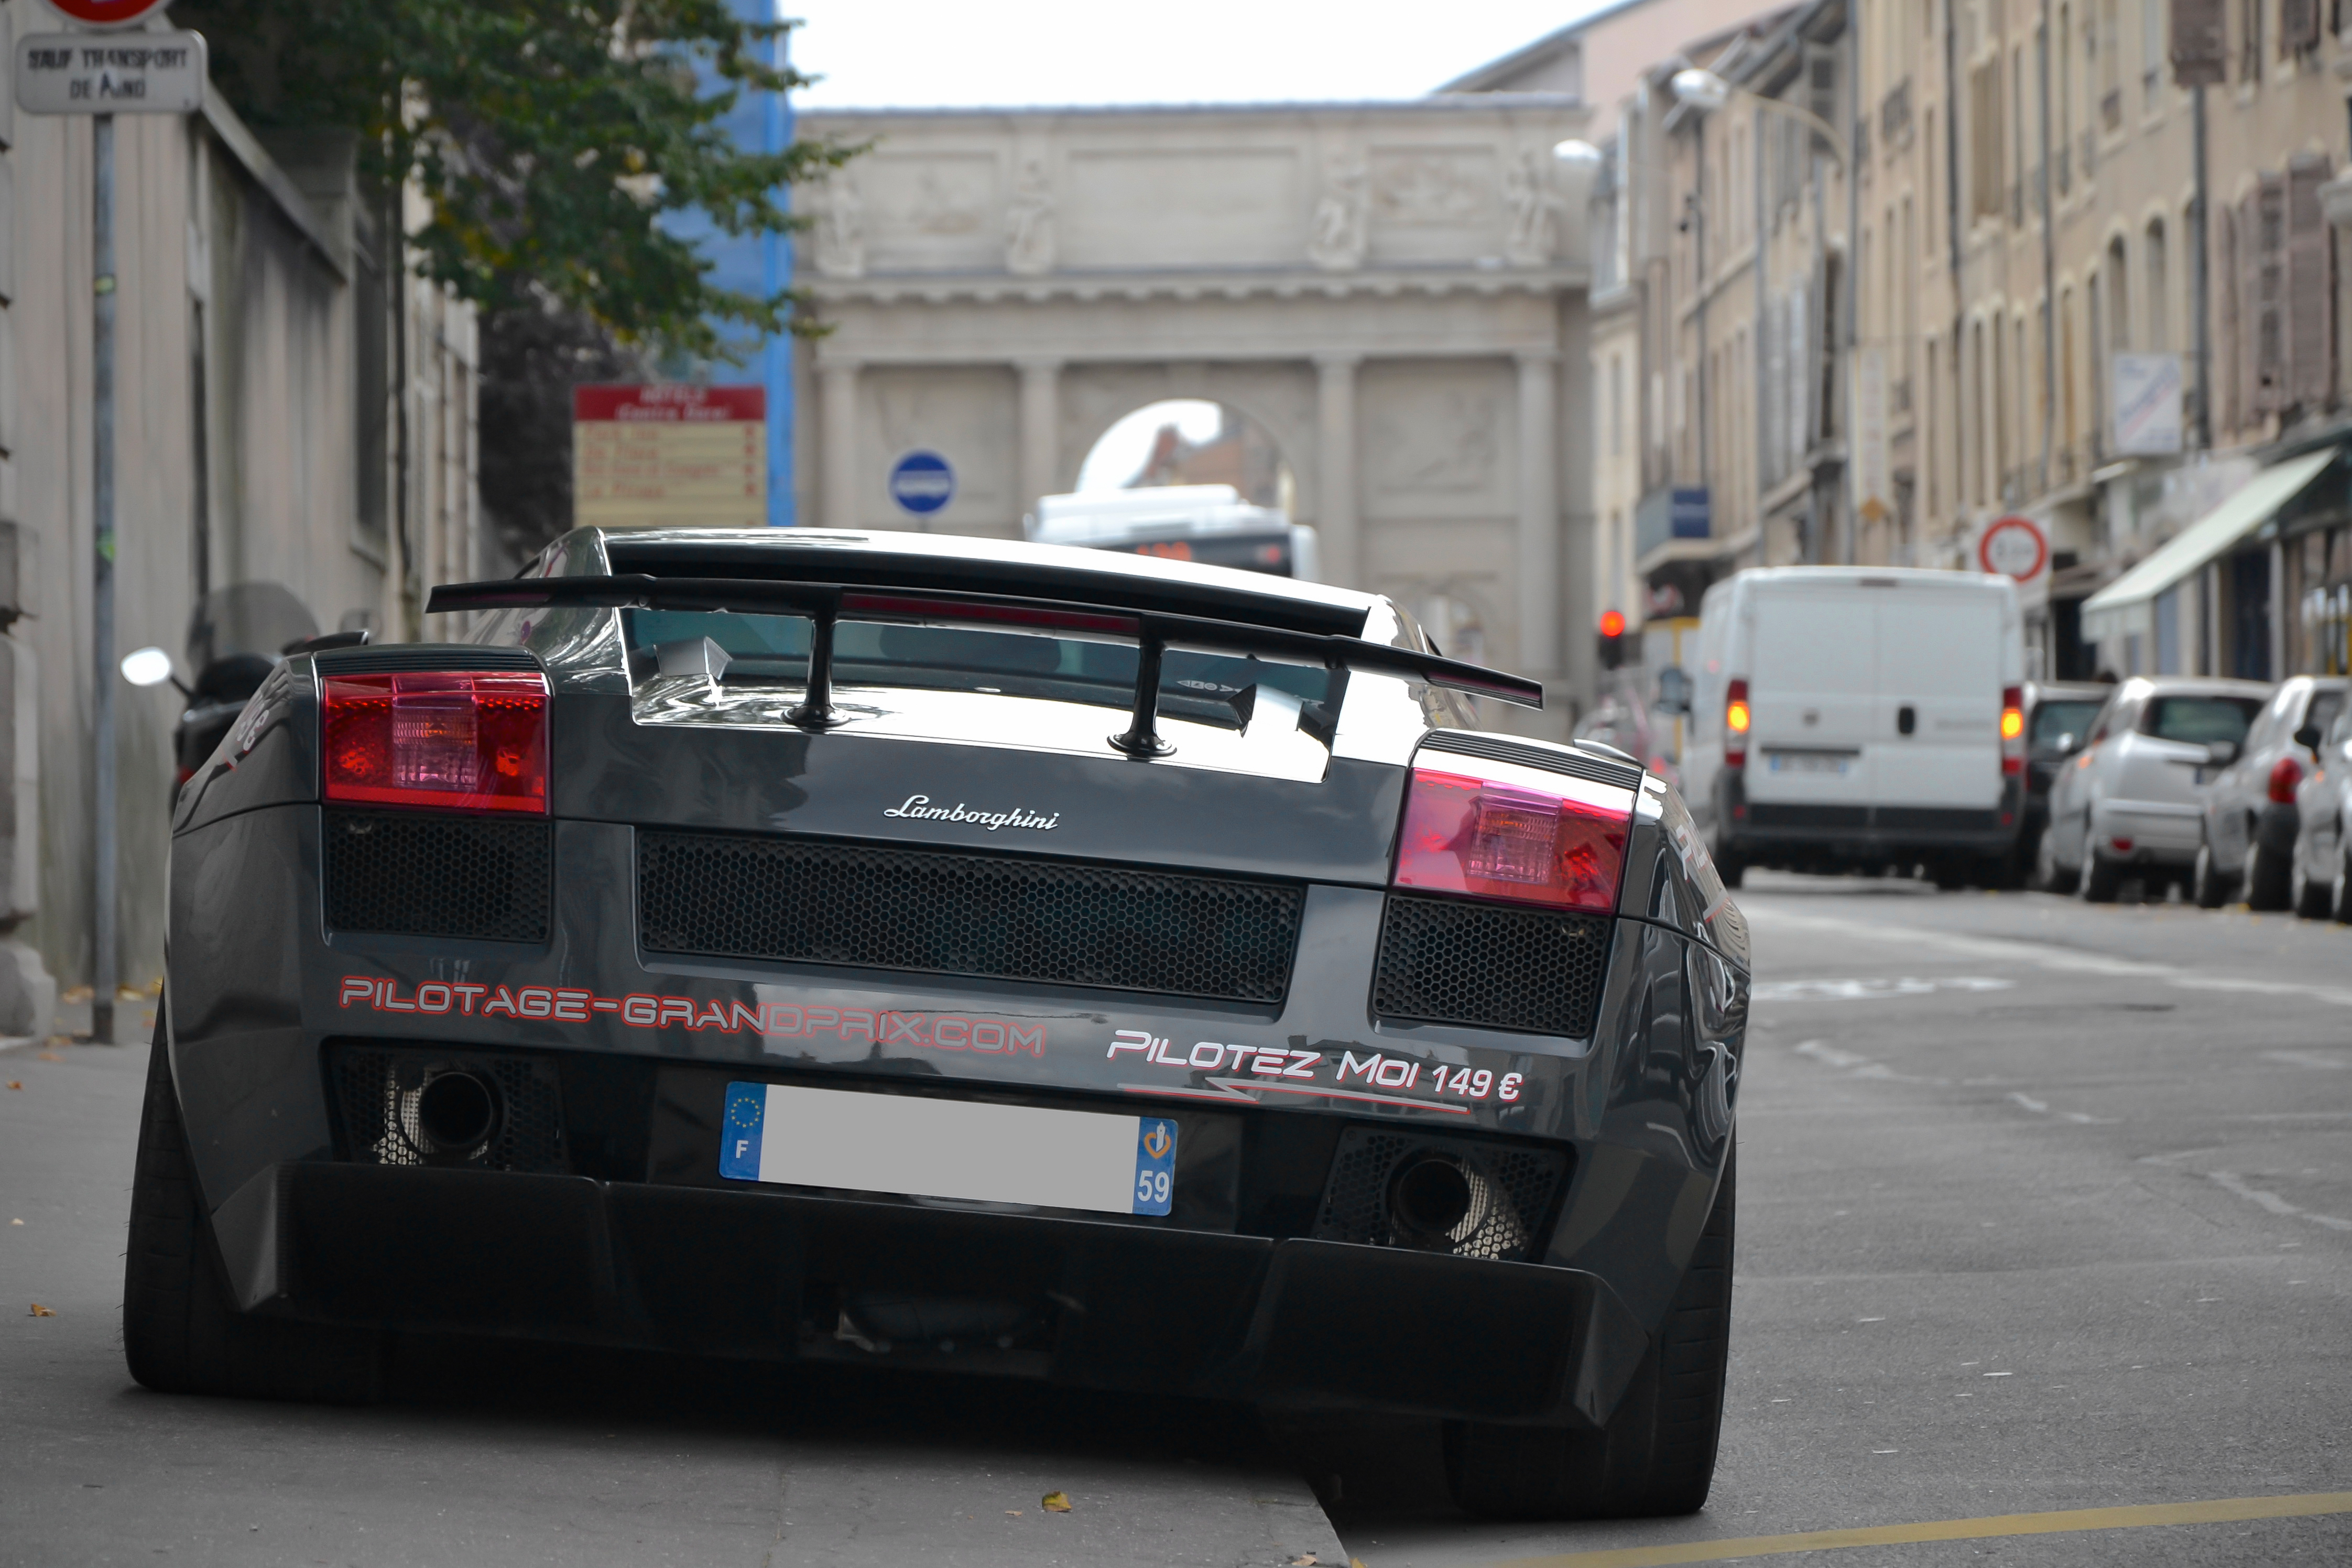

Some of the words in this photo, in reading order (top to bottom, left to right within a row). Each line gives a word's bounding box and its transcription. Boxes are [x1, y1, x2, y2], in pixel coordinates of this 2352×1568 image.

[82, 48, 187, 69] TRANSPORT
[883, 794, 1060, 831] Lamborghini
[340, 976, 1045, 1057] PILOTAGE-GRANDPRIX.COM
[1106, 1029, 1322, 1079] PILOTEZ
[1335, 1050, 1420, 1088] MOI
[1432, 1065, 1493, 1099] 149
[1498, 1073, 1523, 1102] €
[735, 1140, 749, 1159] F
[1137, 1170, 1170, 1204] 59
